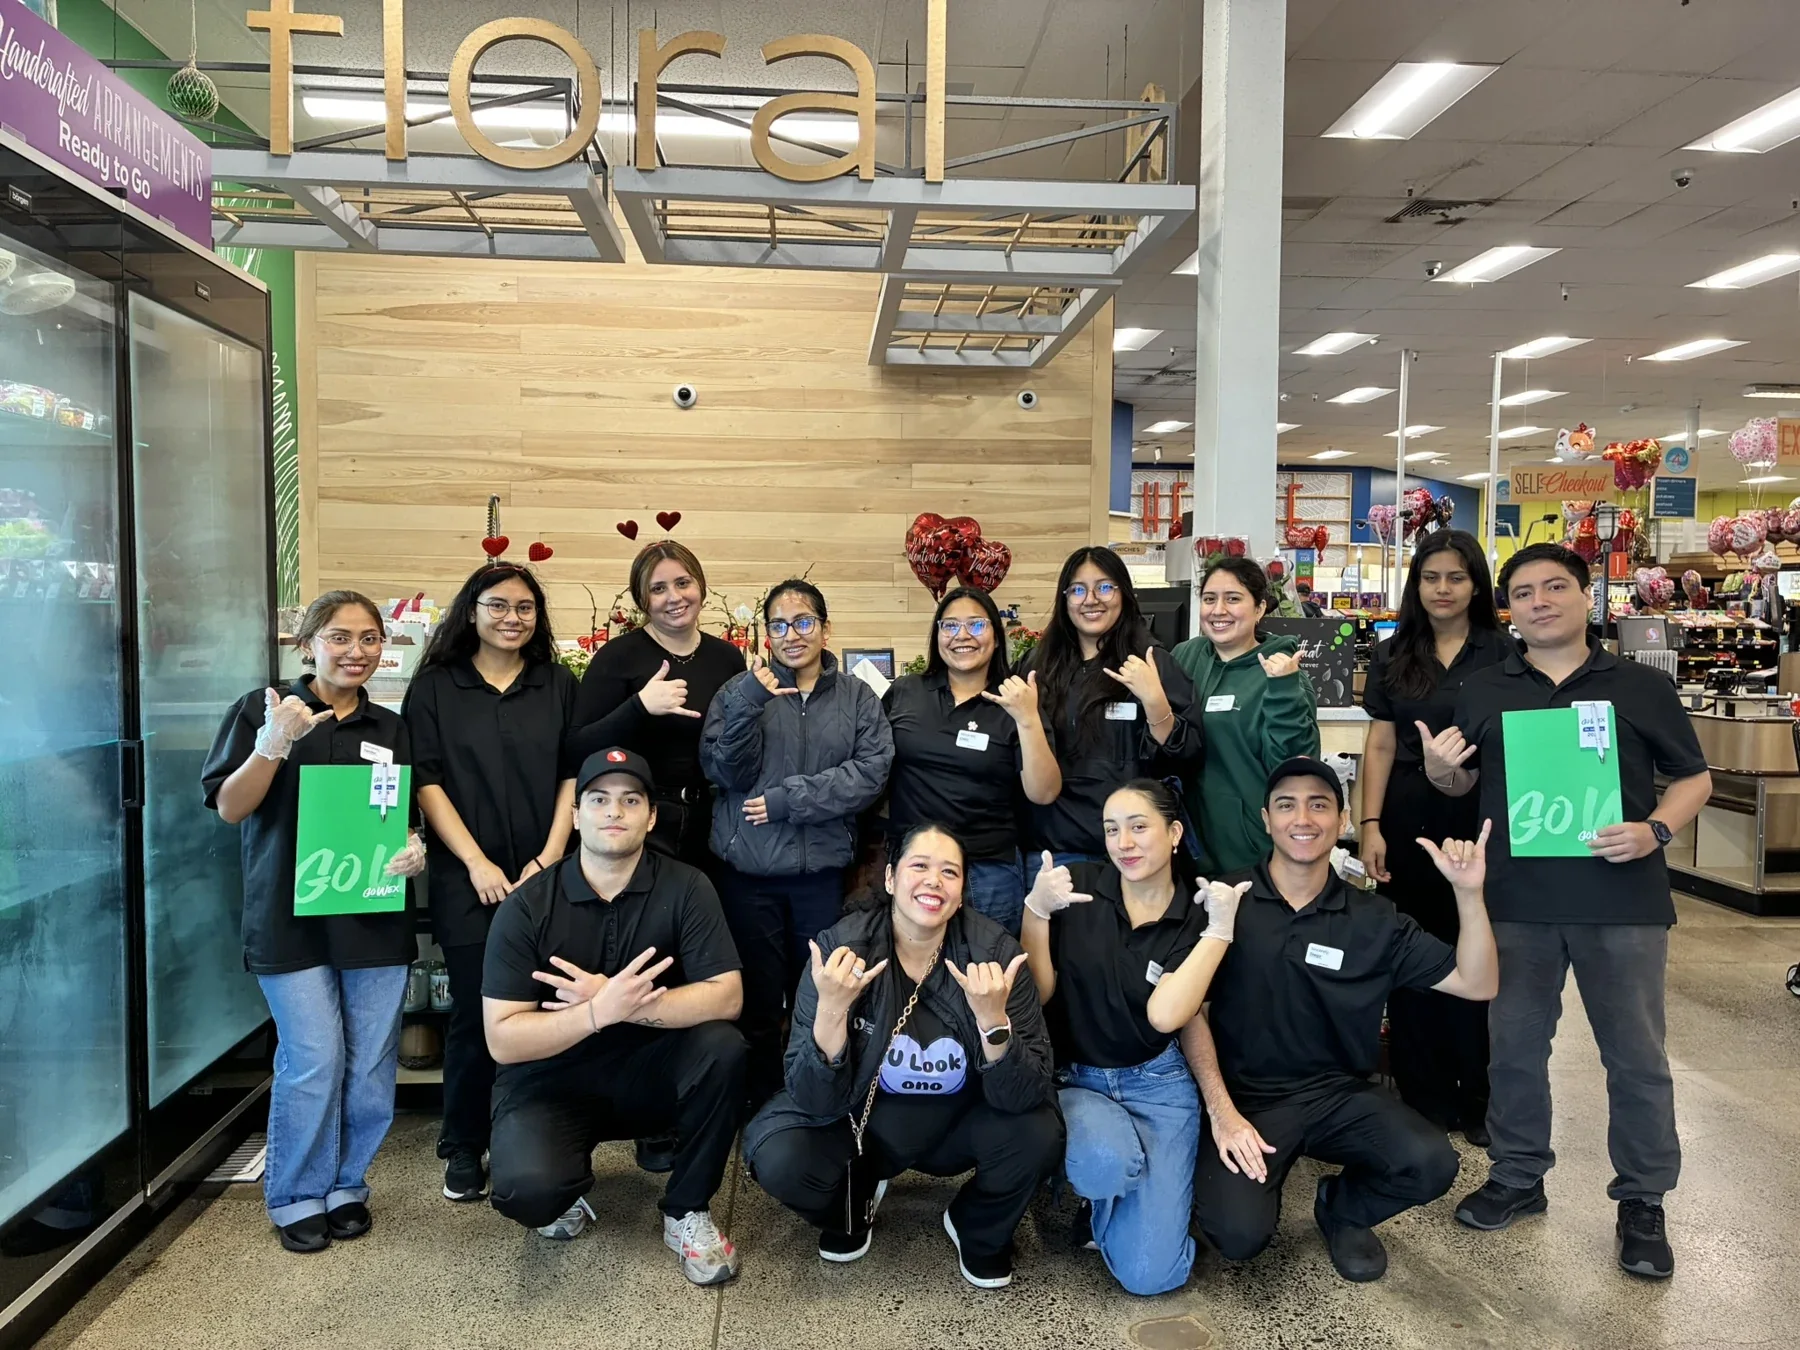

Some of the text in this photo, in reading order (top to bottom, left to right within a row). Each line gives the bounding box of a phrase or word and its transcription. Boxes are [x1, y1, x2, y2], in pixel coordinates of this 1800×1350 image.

[93, 80, 203, 201] ARRANGEMENTS
[59, 119, 151, 200] Ready to Go
[1515, 470, 1608, 496] SELF Checkout
[1615, 555, 1620, 575] 1
[887, 1048, 962, 1074] U Look
[901, 1080, 943, 1091] ono
